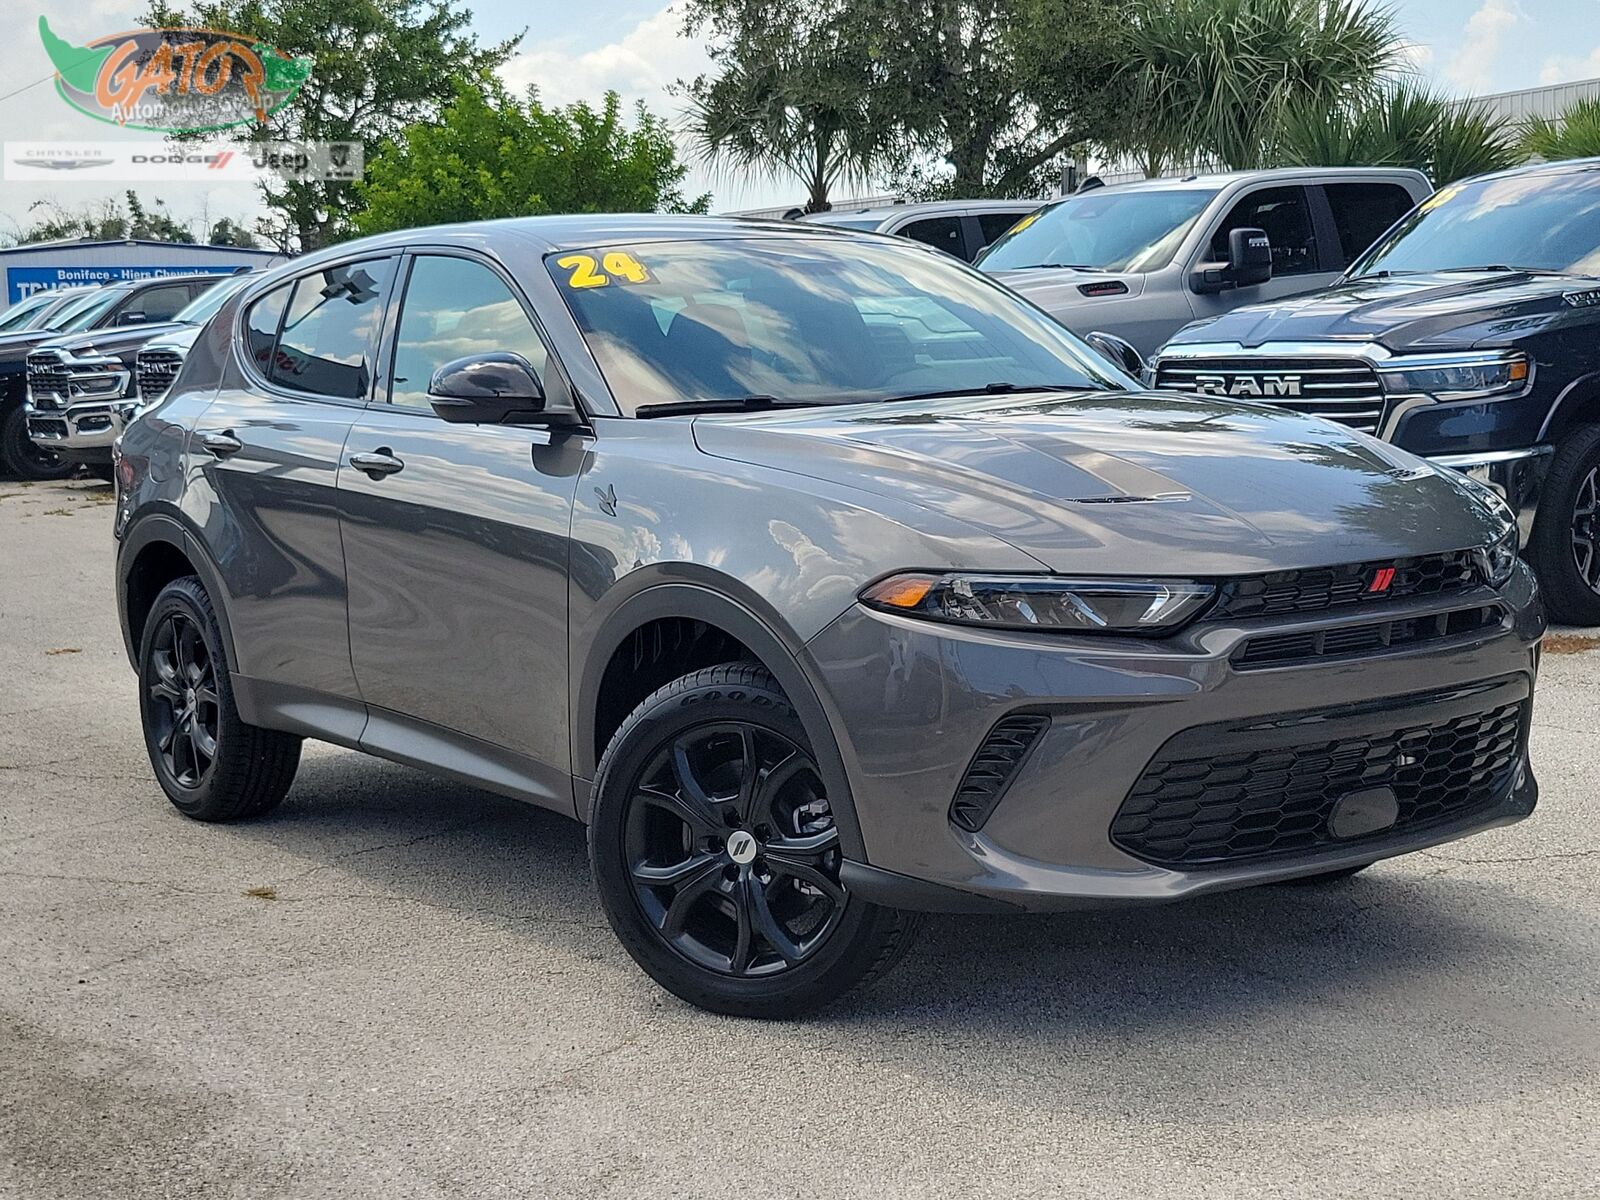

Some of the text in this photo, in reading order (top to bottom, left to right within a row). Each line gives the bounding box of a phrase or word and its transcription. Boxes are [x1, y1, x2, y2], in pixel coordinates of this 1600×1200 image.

[57, 269, 110, 280] Boniface
[121, 269, 151, 280] Hiers
[557, 252, 648, 289] 24
[1195, 376, 1302, 396] RAM
